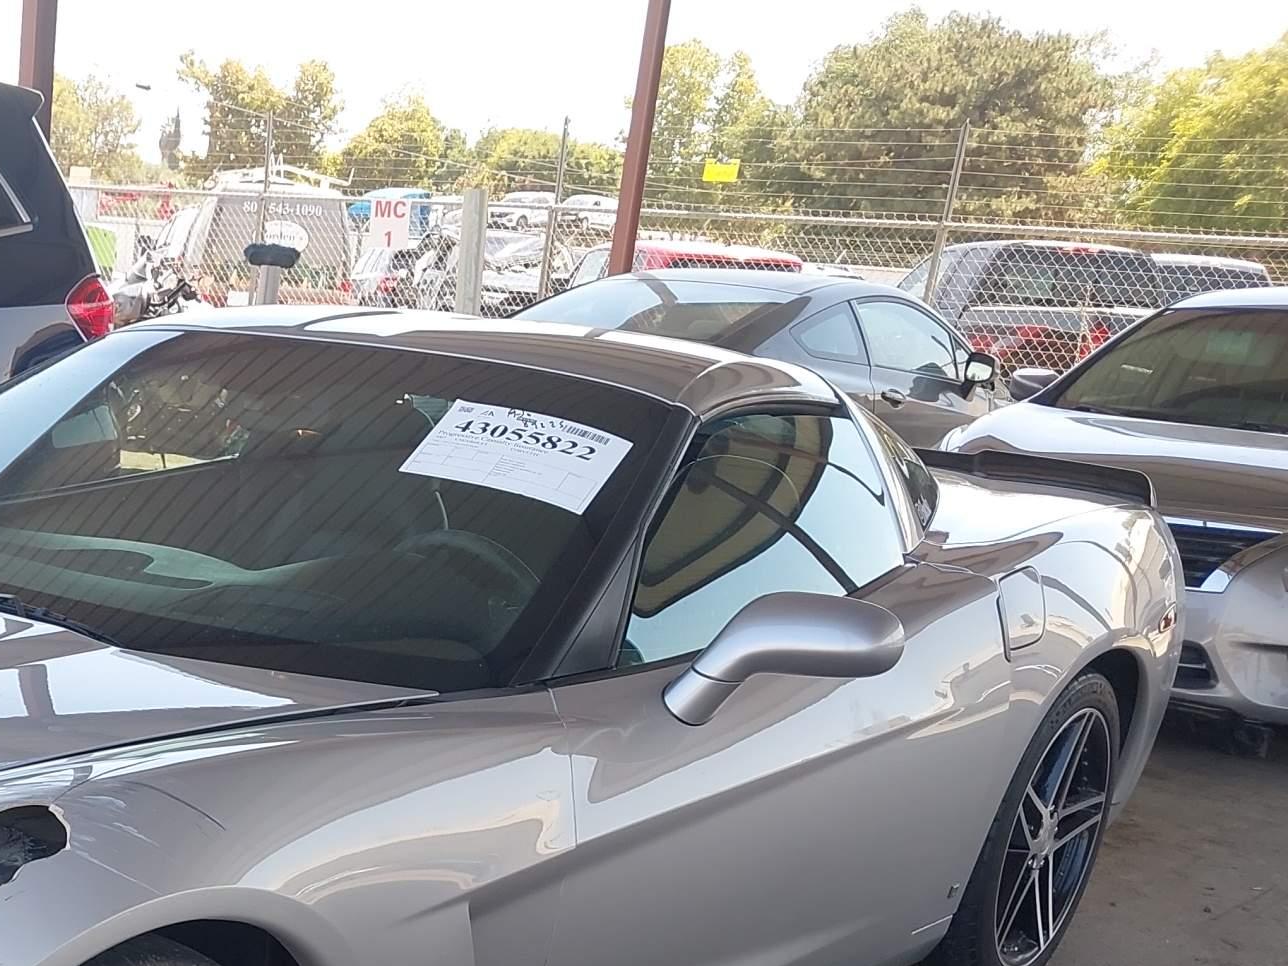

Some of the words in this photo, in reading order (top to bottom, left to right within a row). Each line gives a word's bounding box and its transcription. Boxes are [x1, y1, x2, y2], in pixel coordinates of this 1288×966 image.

[374, 200, 407, 219] MC
[384, 230, 393, 248] 1
[454, 419, 597, 461] 43055822
